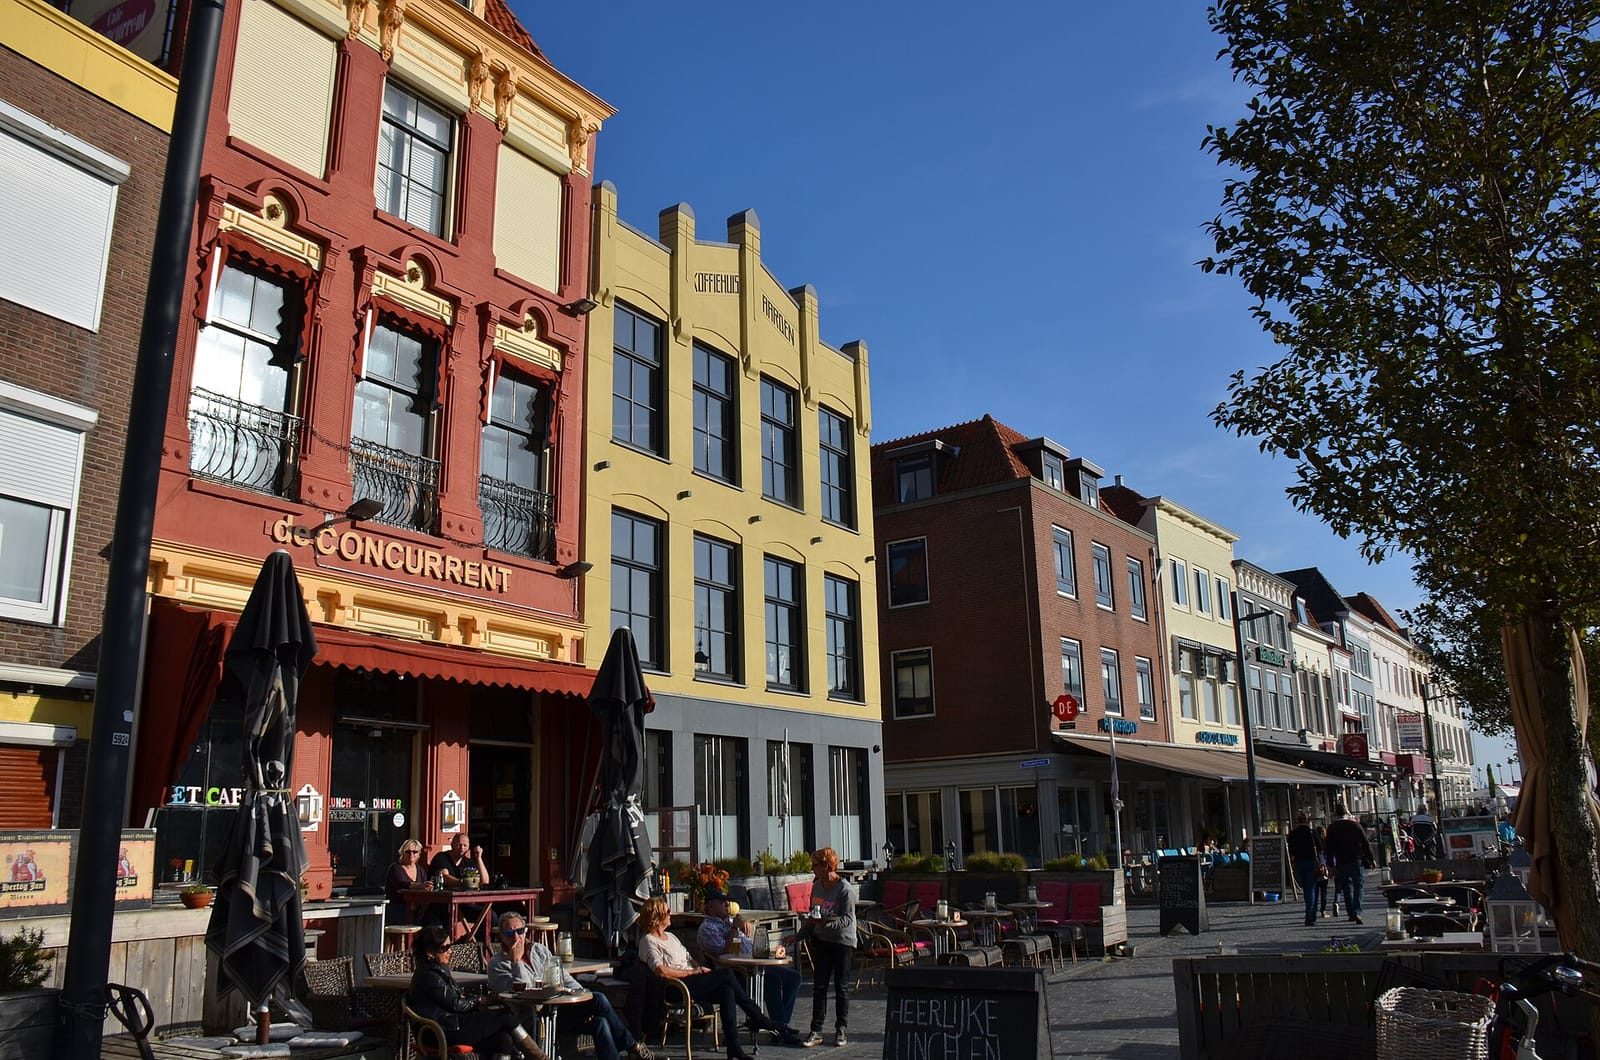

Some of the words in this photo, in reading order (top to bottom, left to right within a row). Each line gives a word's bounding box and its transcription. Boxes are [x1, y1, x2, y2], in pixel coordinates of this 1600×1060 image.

[273, 514, 311, 547] de
[316, 526, 513, 593] CONCURRENT
[206, 787, 247, 806] CAF
[329, 797, 352, 809] UNCH
[372, 797, 402, 810] DINNER
